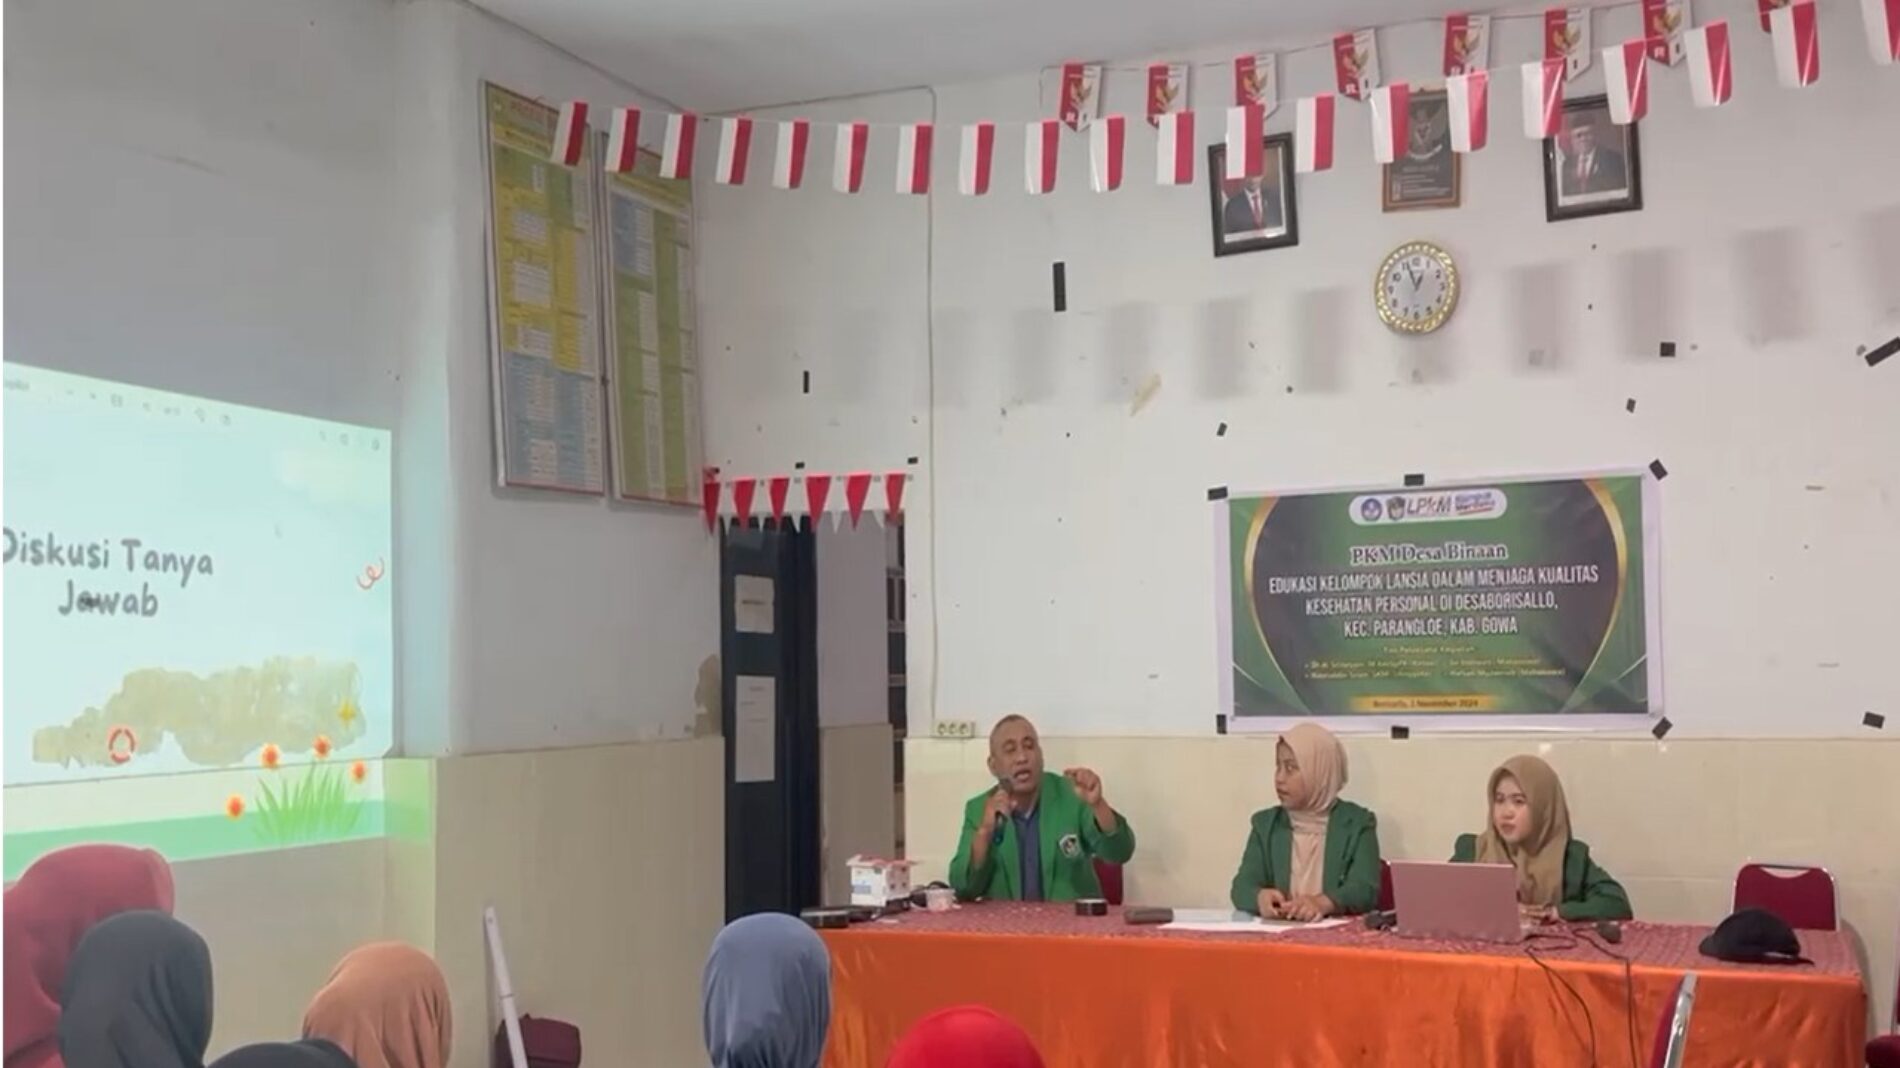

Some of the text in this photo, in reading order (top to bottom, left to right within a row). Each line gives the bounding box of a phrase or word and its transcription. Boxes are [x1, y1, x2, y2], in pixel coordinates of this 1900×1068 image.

[3, 527, 213, 588] Diskusi Tanya
[1351, 542, 1508, 566] PKM Desa Binaan
[1269, 565, 1598, 594] EDUKASI KELOMPOK LANSIA DALAM MENJAGA KUALITAS
[58, 579, 159, 617] Jawab
[1306, 597, 1372, 615] KESEHATAN
[1375, 594, 1437, 613] PERSONAL
[1440, 594, 1452, 611] DI
[1344, 616, 1518, 637] KEC. PARANGLOE, KAB. GOWA
